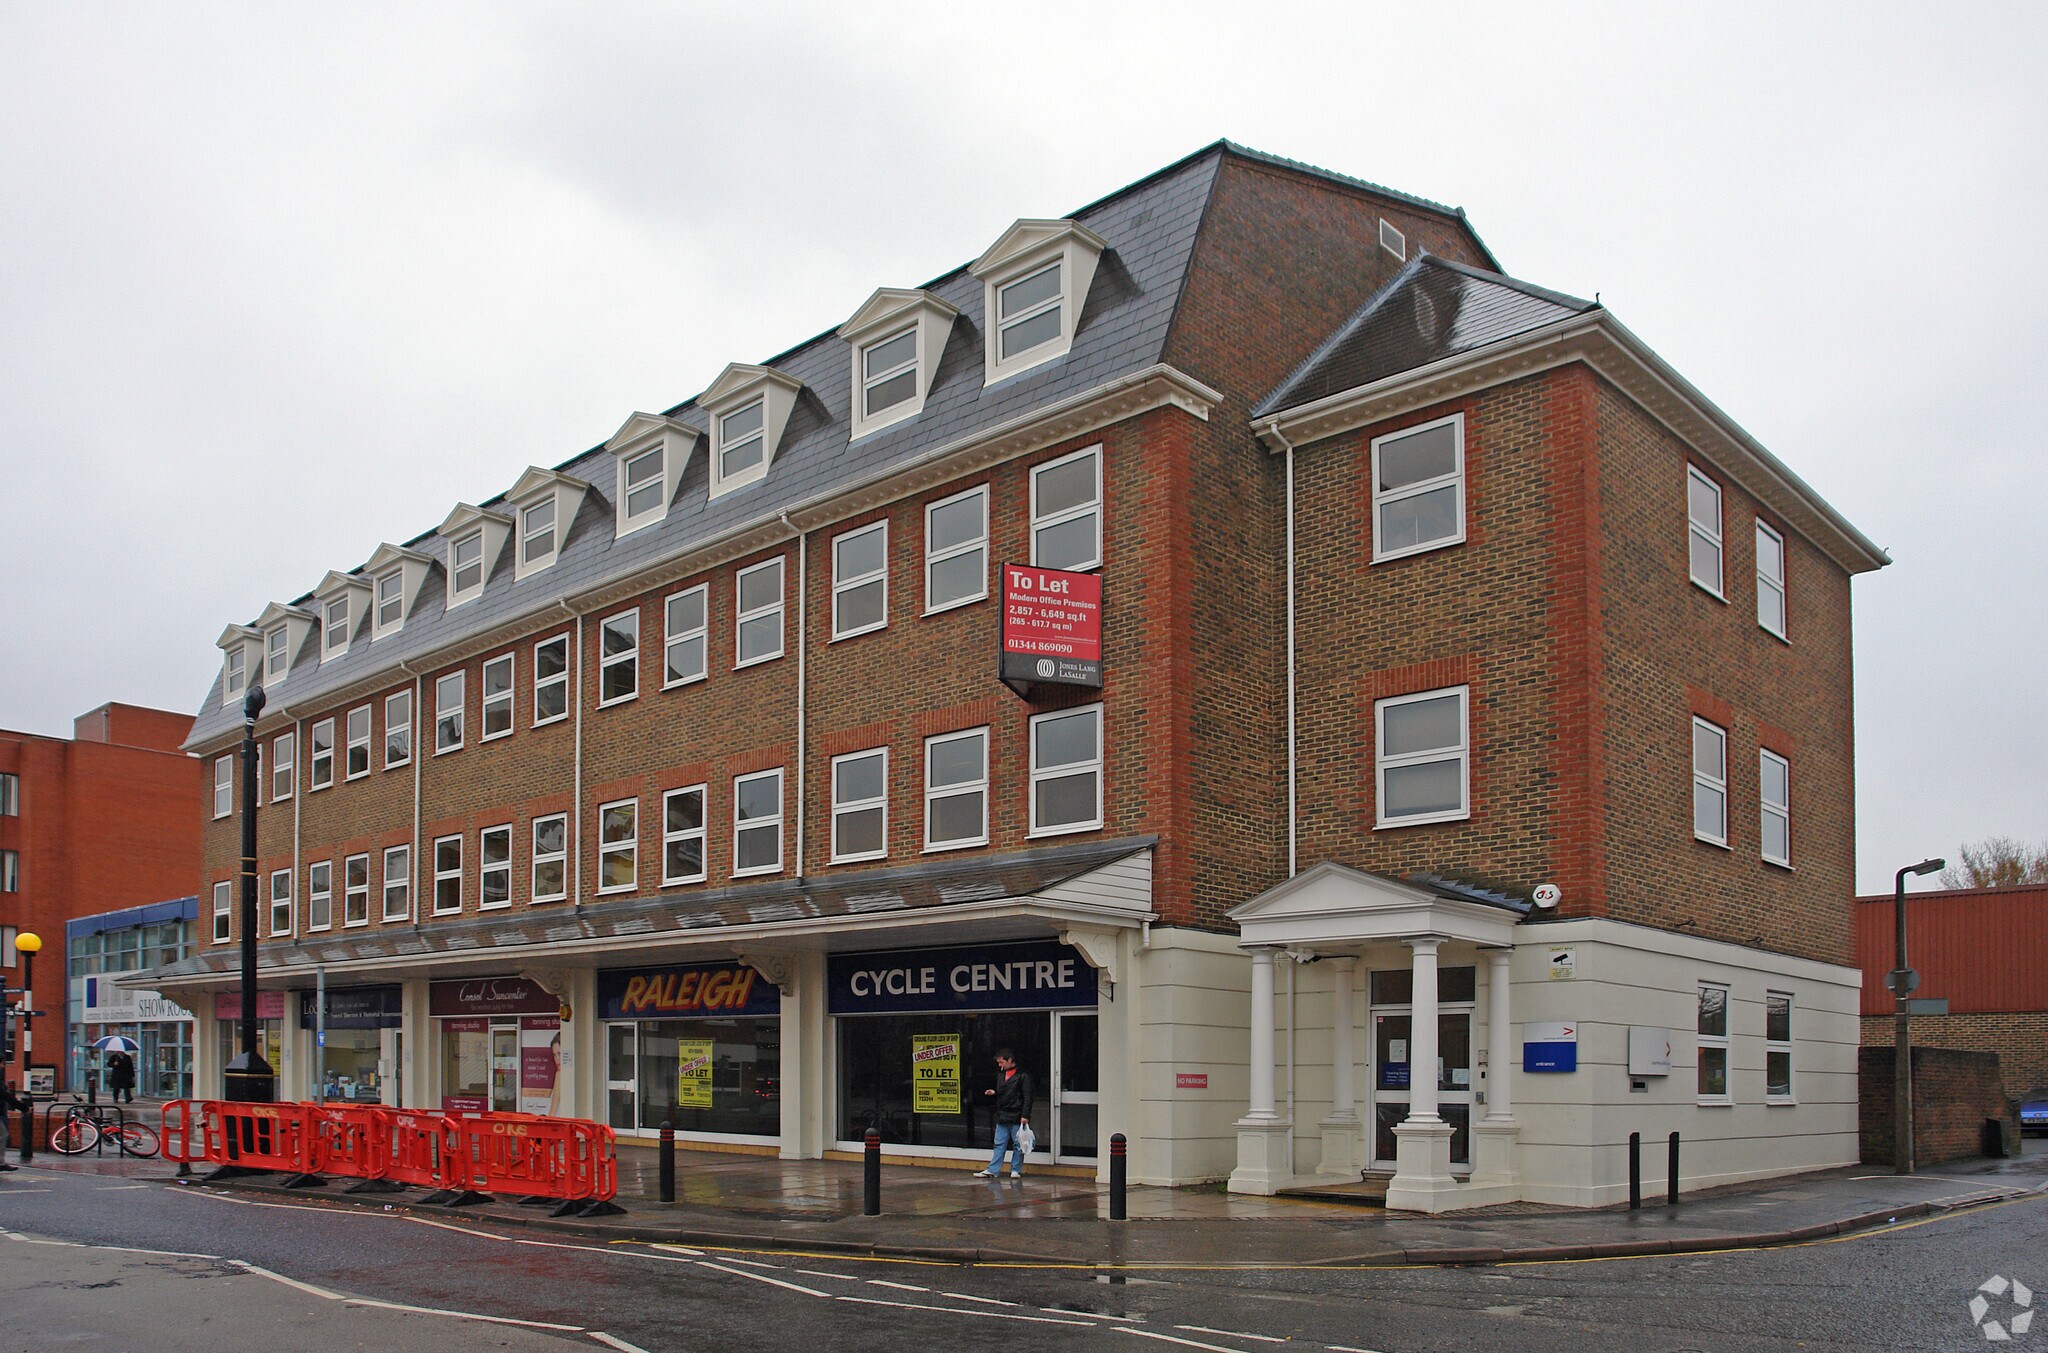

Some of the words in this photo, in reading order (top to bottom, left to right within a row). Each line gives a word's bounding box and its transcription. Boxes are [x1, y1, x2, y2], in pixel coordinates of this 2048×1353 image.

[1009, 571, 1032, 589] To
[1039, 574, 1069, 594] Let
[1009, 592, 1038, 603] Modern
[1039, 596, 1062, 605] Office
[1063, 599, 1097, 609] Premises
[1009, 605, 1033, 616] 2,857
[1067, 612, 1087, 622] sq.ft
[1009, 617, 1026, 626] (265
[1031, 619, 1050, 628] 617.7
[1052, 622, 1061, 631] sq
[1062, 623, 1073, 631] m)
[1008, 639, 1036, 650] 01344
[1038, 643, 1073, 653] 869090
[850, 967, 936, 997] CYCLE
[950, 959, 1075, 993] CENTRE
[620, 969, 757, 1013] RALEIGH
[138, 998, 192, 1018] SHOWROO
[693, 1056, 708, 1067] OFFER
[914, 1049, 934, 1062] UNDER
[934, 1045, 954, 1057] OFFER
[696, 1069, 709, 1077] LET
[920, 1068, 933, 1078] TO
[936, 1068, 954, 1078] LET
[1185, 1077, 1207, 1085] PARKING
